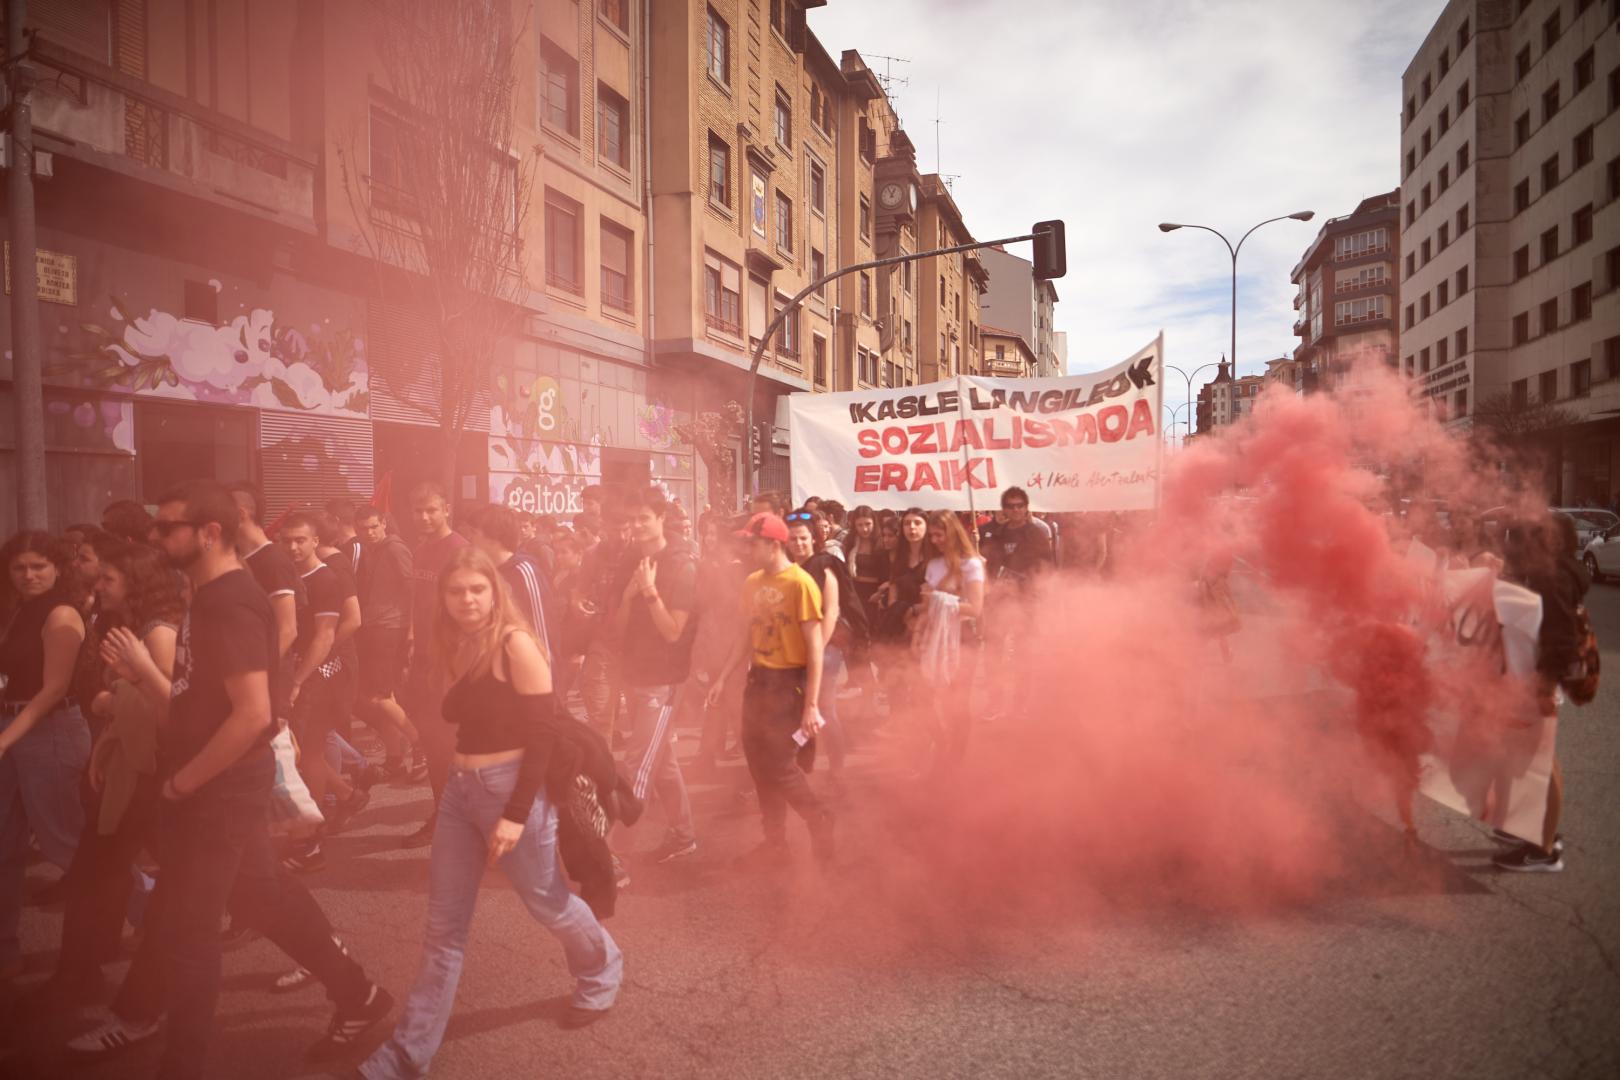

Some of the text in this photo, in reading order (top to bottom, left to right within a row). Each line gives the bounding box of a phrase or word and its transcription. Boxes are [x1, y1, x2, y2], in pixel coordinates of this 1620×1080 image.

[538, 387, 556, 431] g
[849, 356, 1156, 423] IKASLE LANGILEOK
[857, 398, 1155, 459] SOZIALISMOA
[854, 457, 998, 493] ERAIKI
